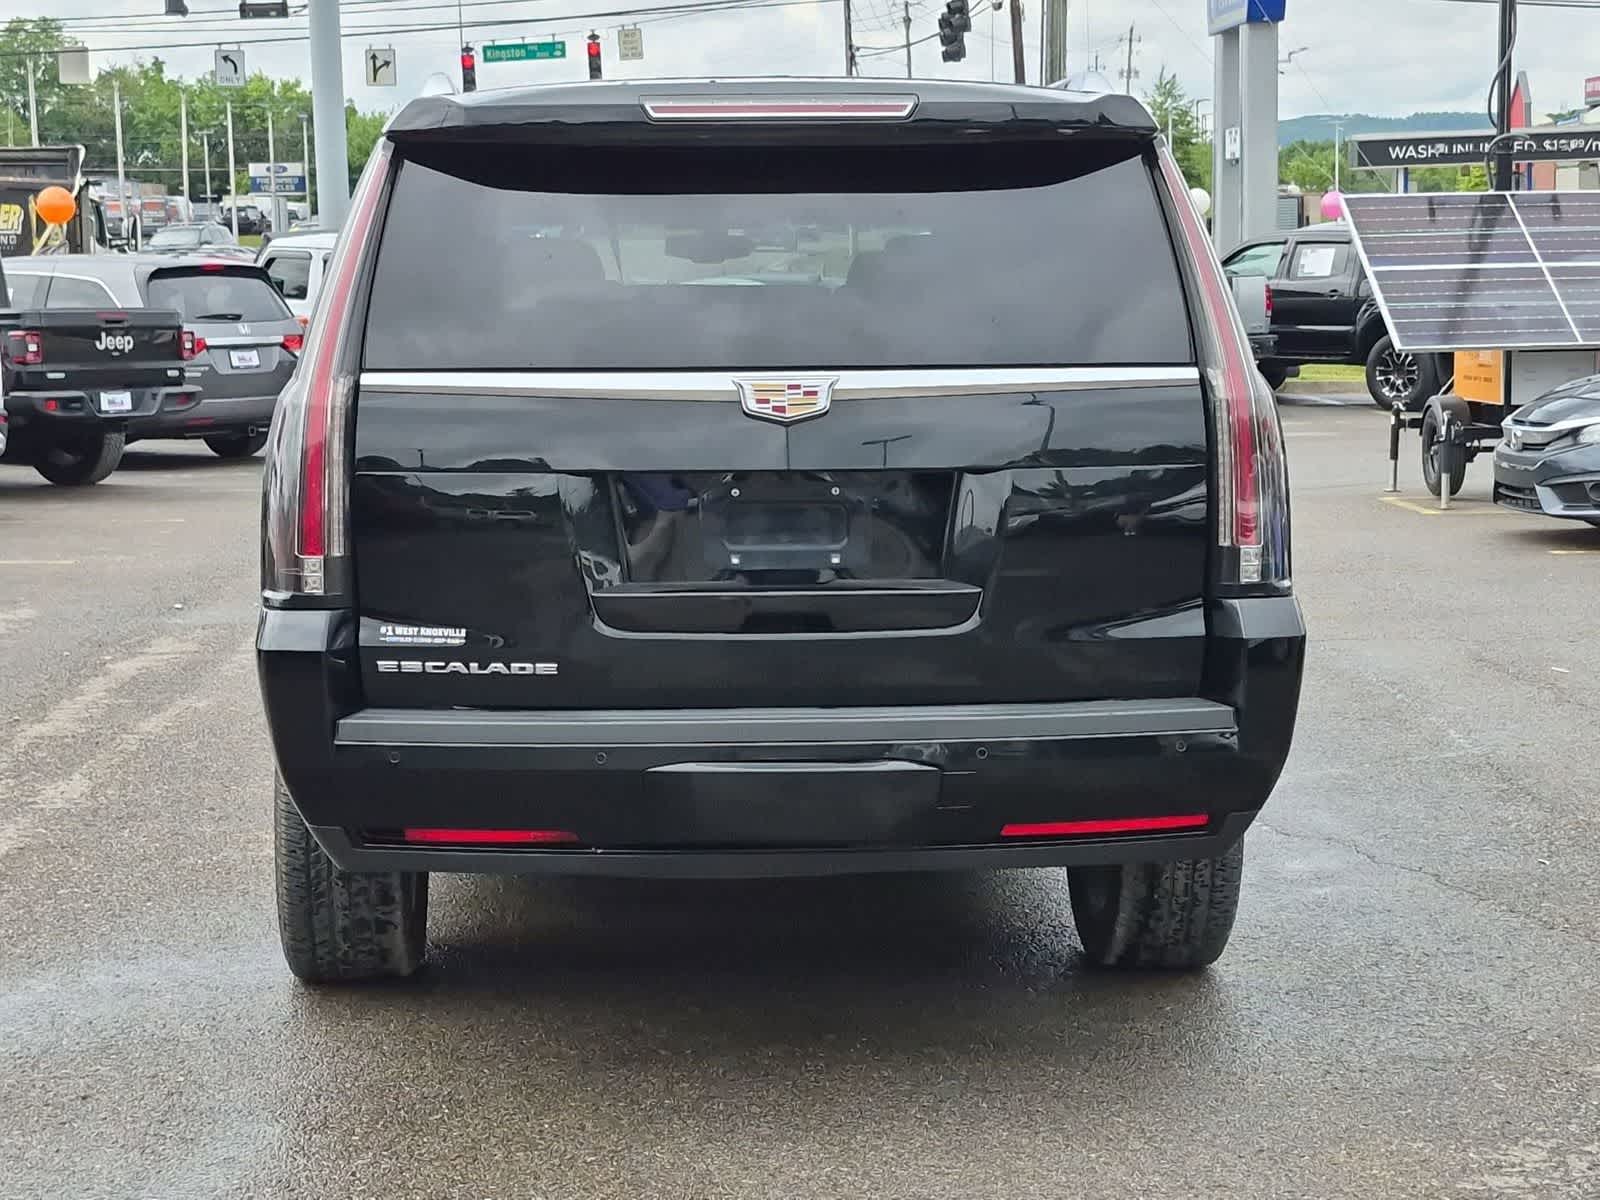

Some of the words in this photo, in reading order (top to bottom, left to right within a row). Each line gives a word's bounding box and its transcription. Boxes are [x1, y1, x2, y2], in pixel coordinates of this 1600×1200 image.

[486, 46, 526, 60] Kingston
[1388, 144, 1440, 160] WASH
[1444, 140, 1536, 156] UNLIED
[260, 184, 295, 192] VECLES
[95, 331, 134, 353] Jeep
[395, 625, 419, 636] WEST
[420, 626, 467, 637] KNOXVILLE
[376, 660, 558, 676] ESCALADE
